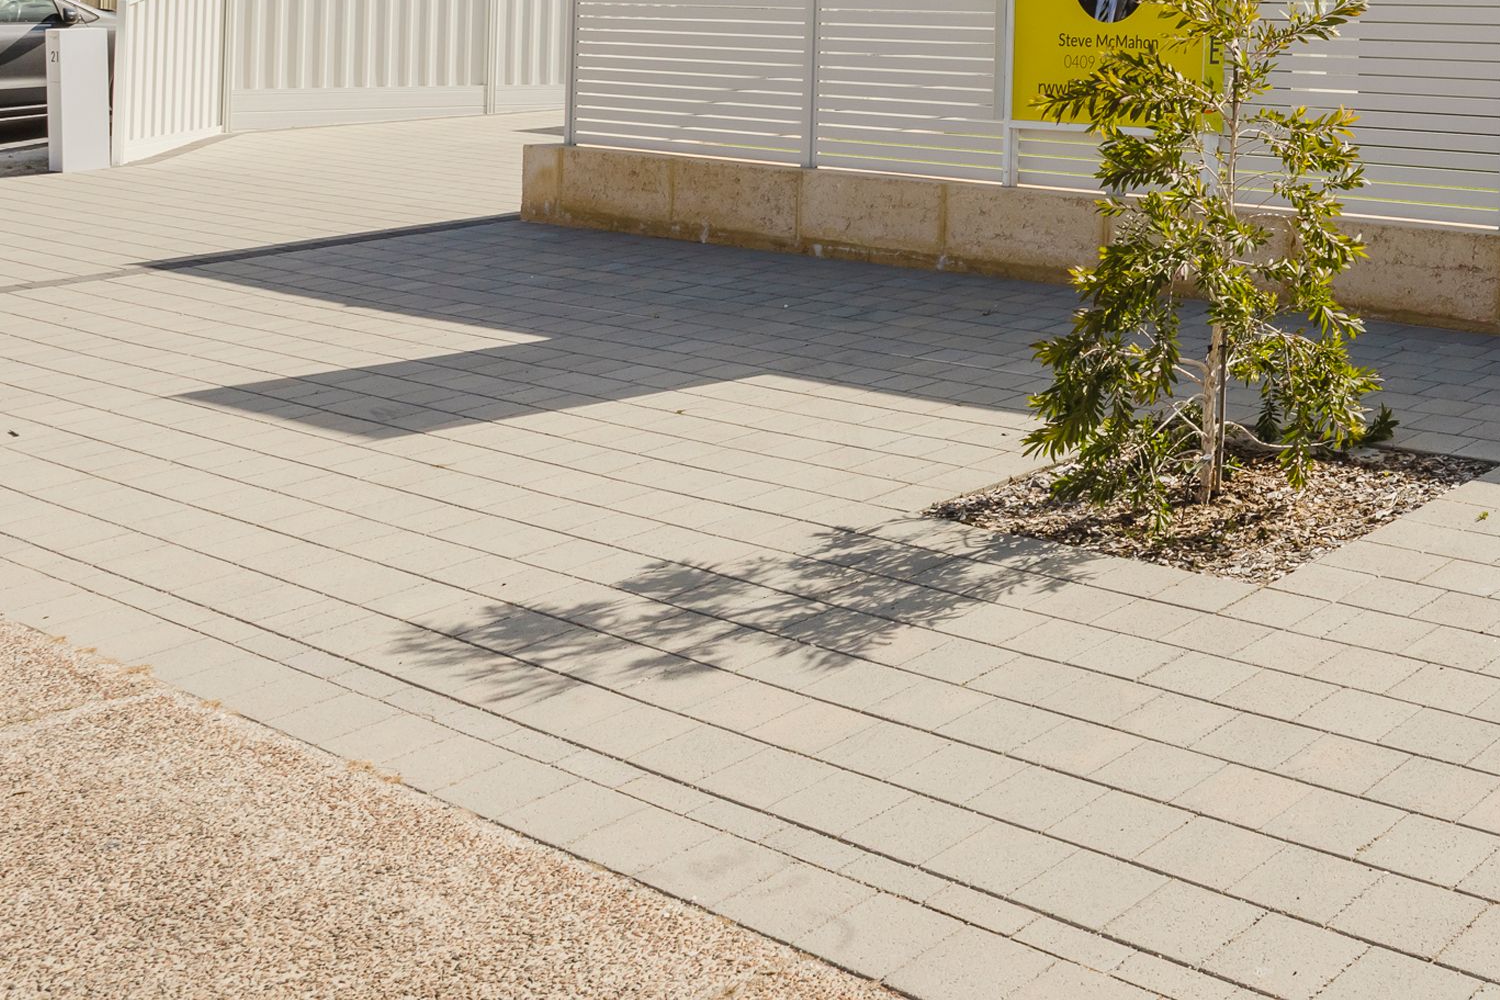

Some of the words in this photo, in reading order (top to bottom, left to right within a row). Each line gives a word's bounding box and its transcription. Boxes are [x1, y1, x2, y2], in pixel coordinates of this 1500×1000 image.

[1058, 33, 1092, 48] Steve
[1095, 34, 1159, 50] McMahon
[50, 50, 59, 63] 21
[1063, 54, 1096, 70] 0409
